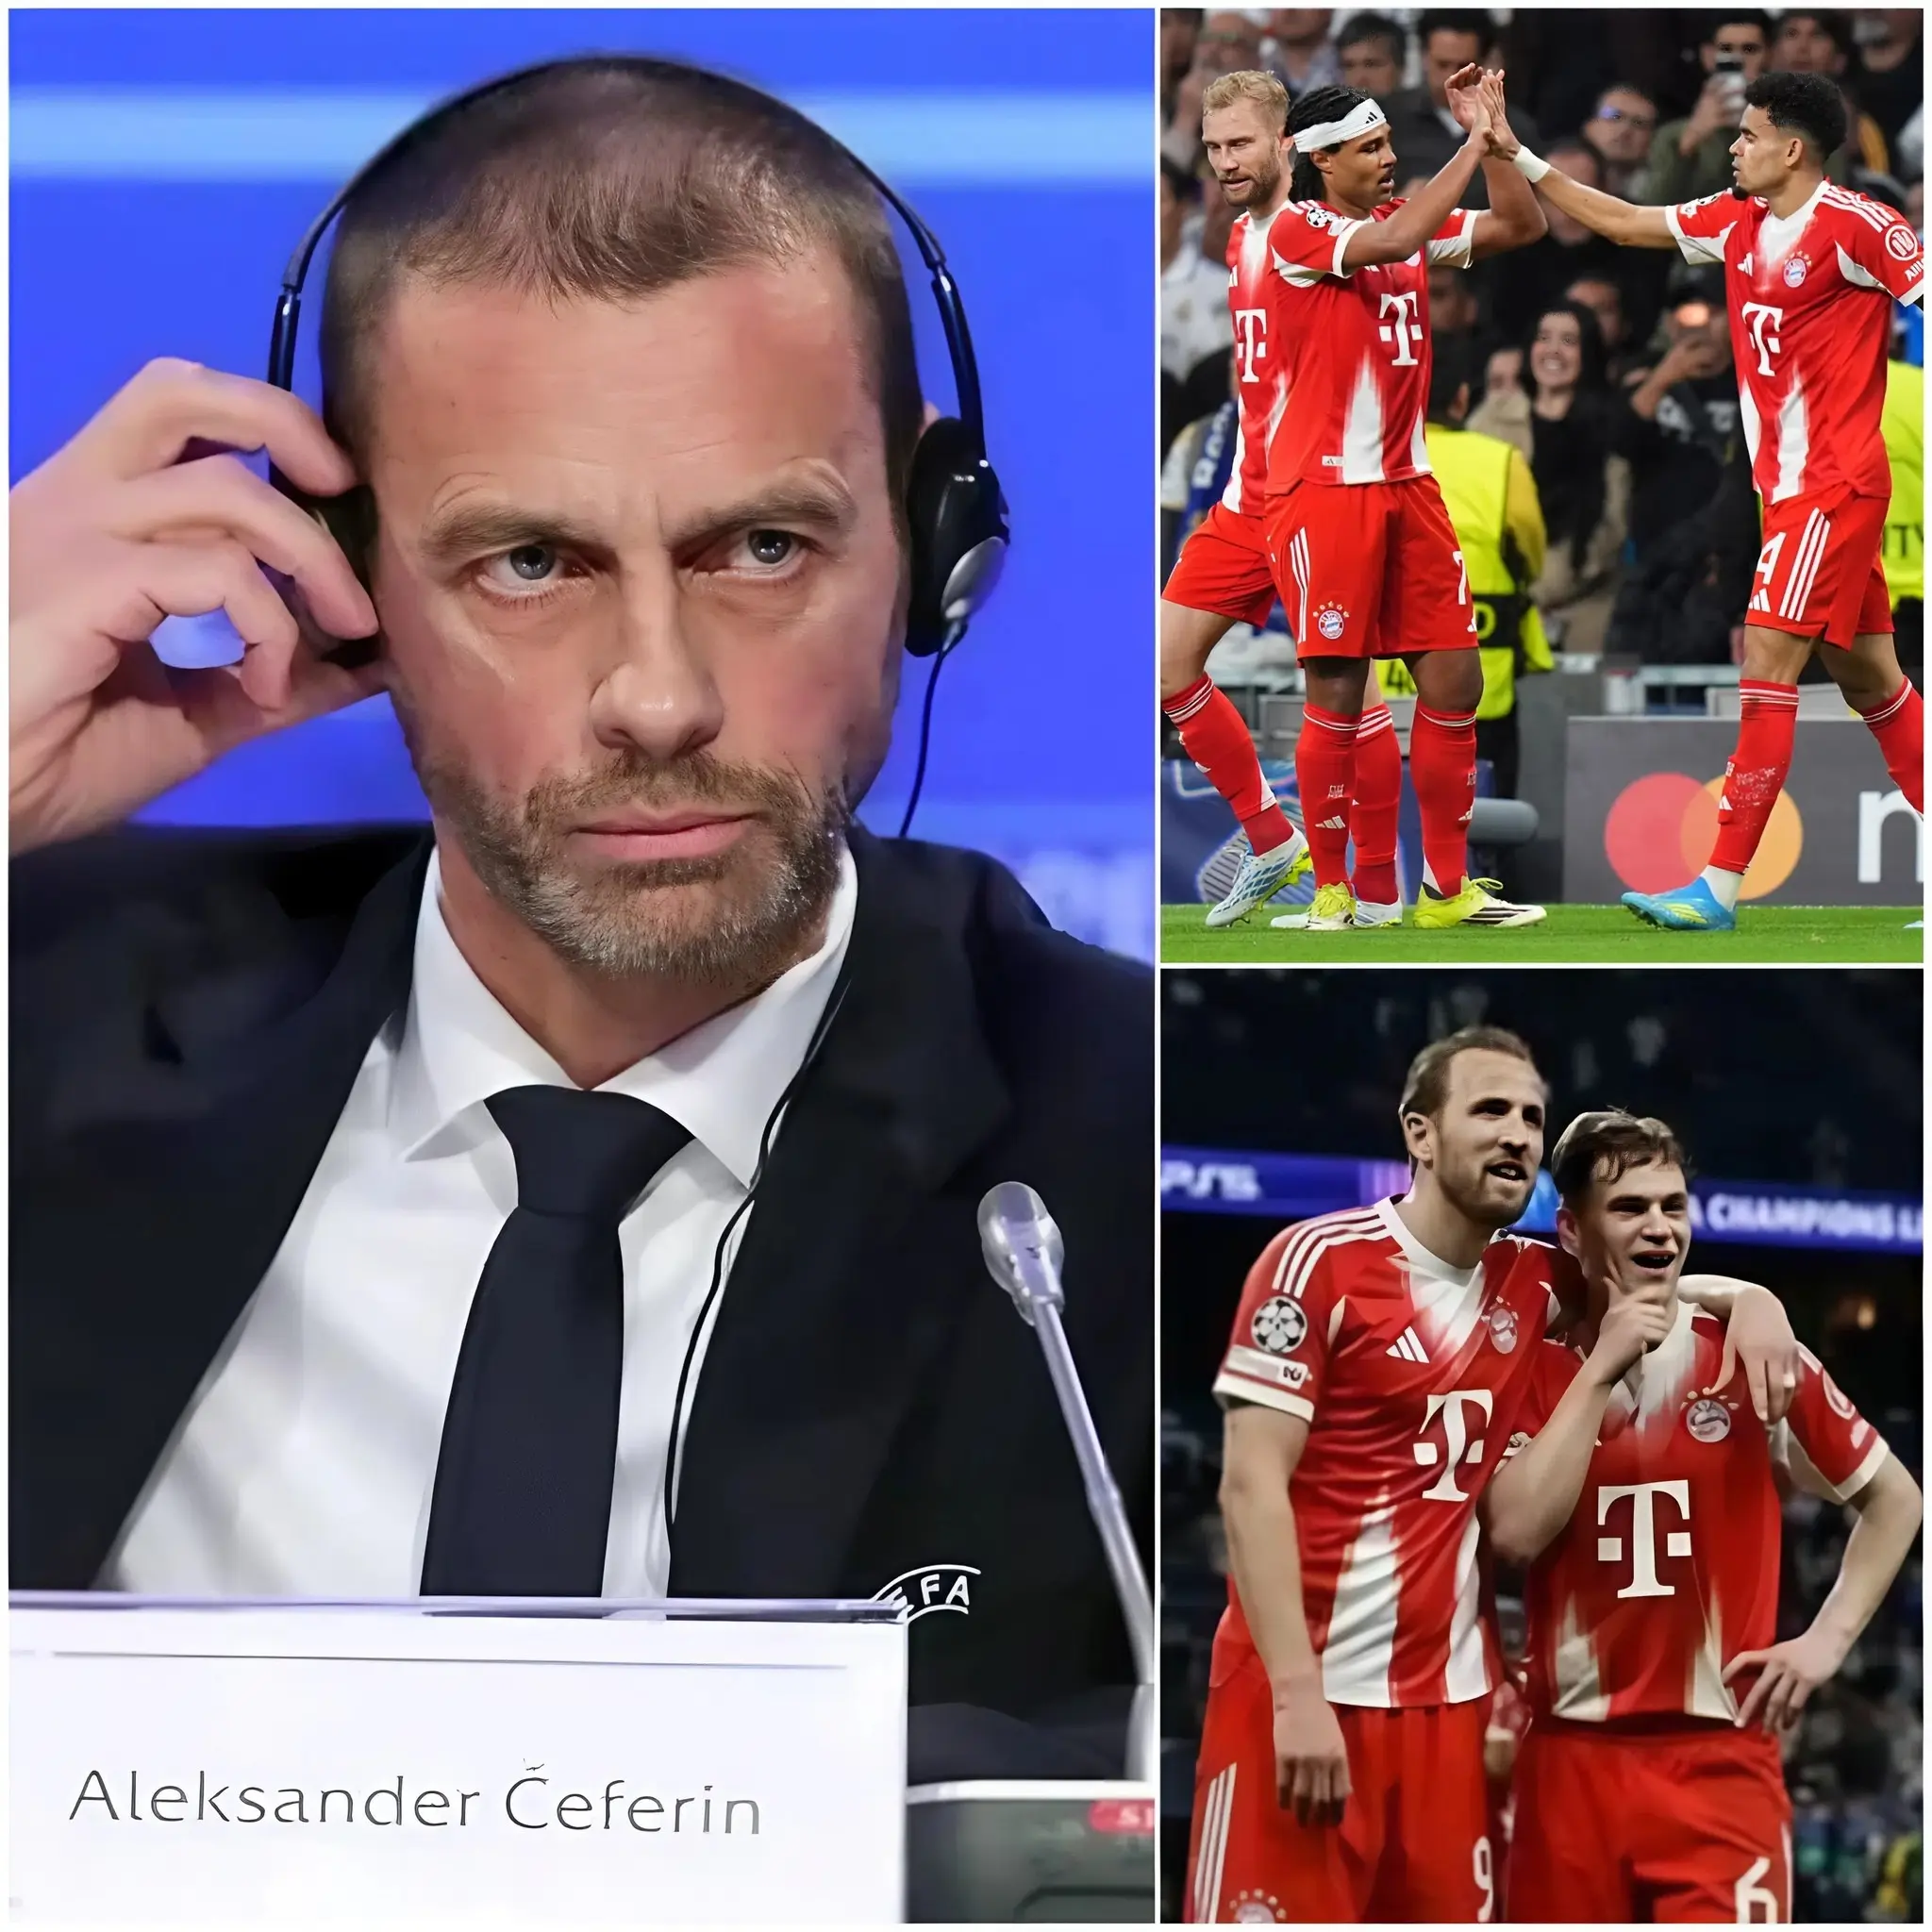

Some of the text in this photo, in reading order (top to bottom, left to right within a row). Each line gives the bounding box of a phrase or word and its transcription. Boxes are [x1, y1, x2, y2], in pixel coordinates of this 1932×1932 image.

[1235, 308, 1267, 383] T
[1379, 291, 1424, 367] T
[1741, 301, 1783, 377] T
[1413, 1389, 1494, 1502] T
[1597, 1479, 1692, 1599] T
[69, 1757, 760, 1835] Aleksander Čeferin
[1473, 1835, 1493, 1923] 9
